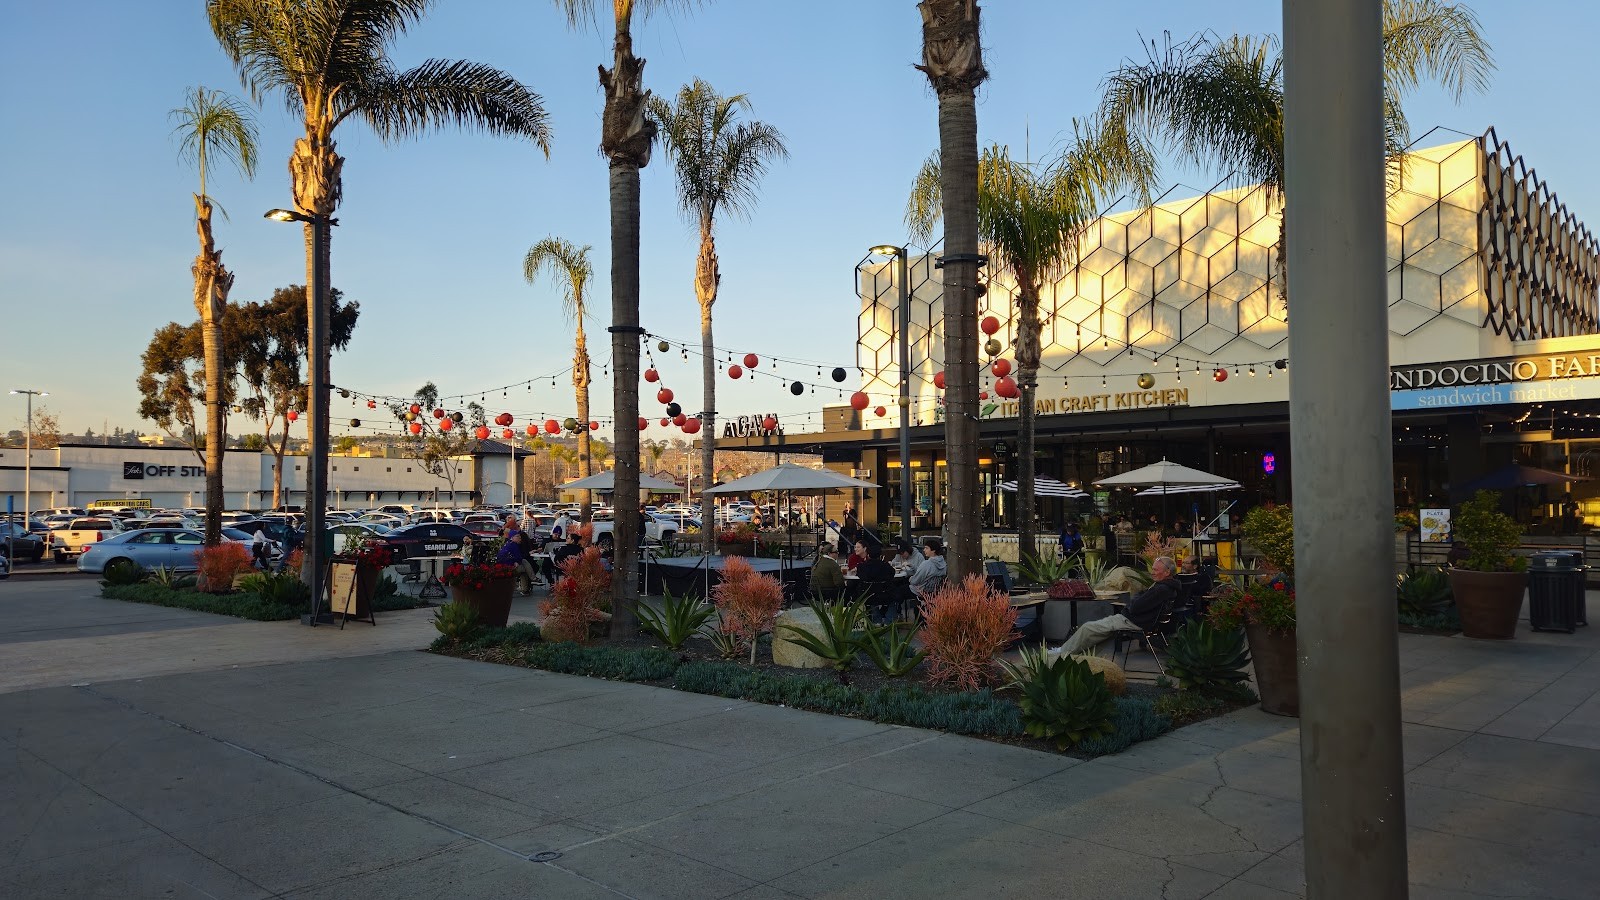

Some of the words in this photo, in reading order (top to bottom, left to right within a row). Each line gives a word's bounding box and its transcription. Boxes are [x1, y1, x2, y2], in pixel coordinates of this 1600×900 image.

[1390, 360, 1538, 389] NDOCINO
[1001, 398, 1056, 416] ITAAN
[1059, 394, 1111, 412] CRAFT
[1115, 388, 1189, 407] KITCHEN
[1418, 387, 1502, 407] sandwich
[1509, 382, 1576, 401] market
[145, 465, 175, 477] OFF
[180, 465, 207, 477] 5TH
